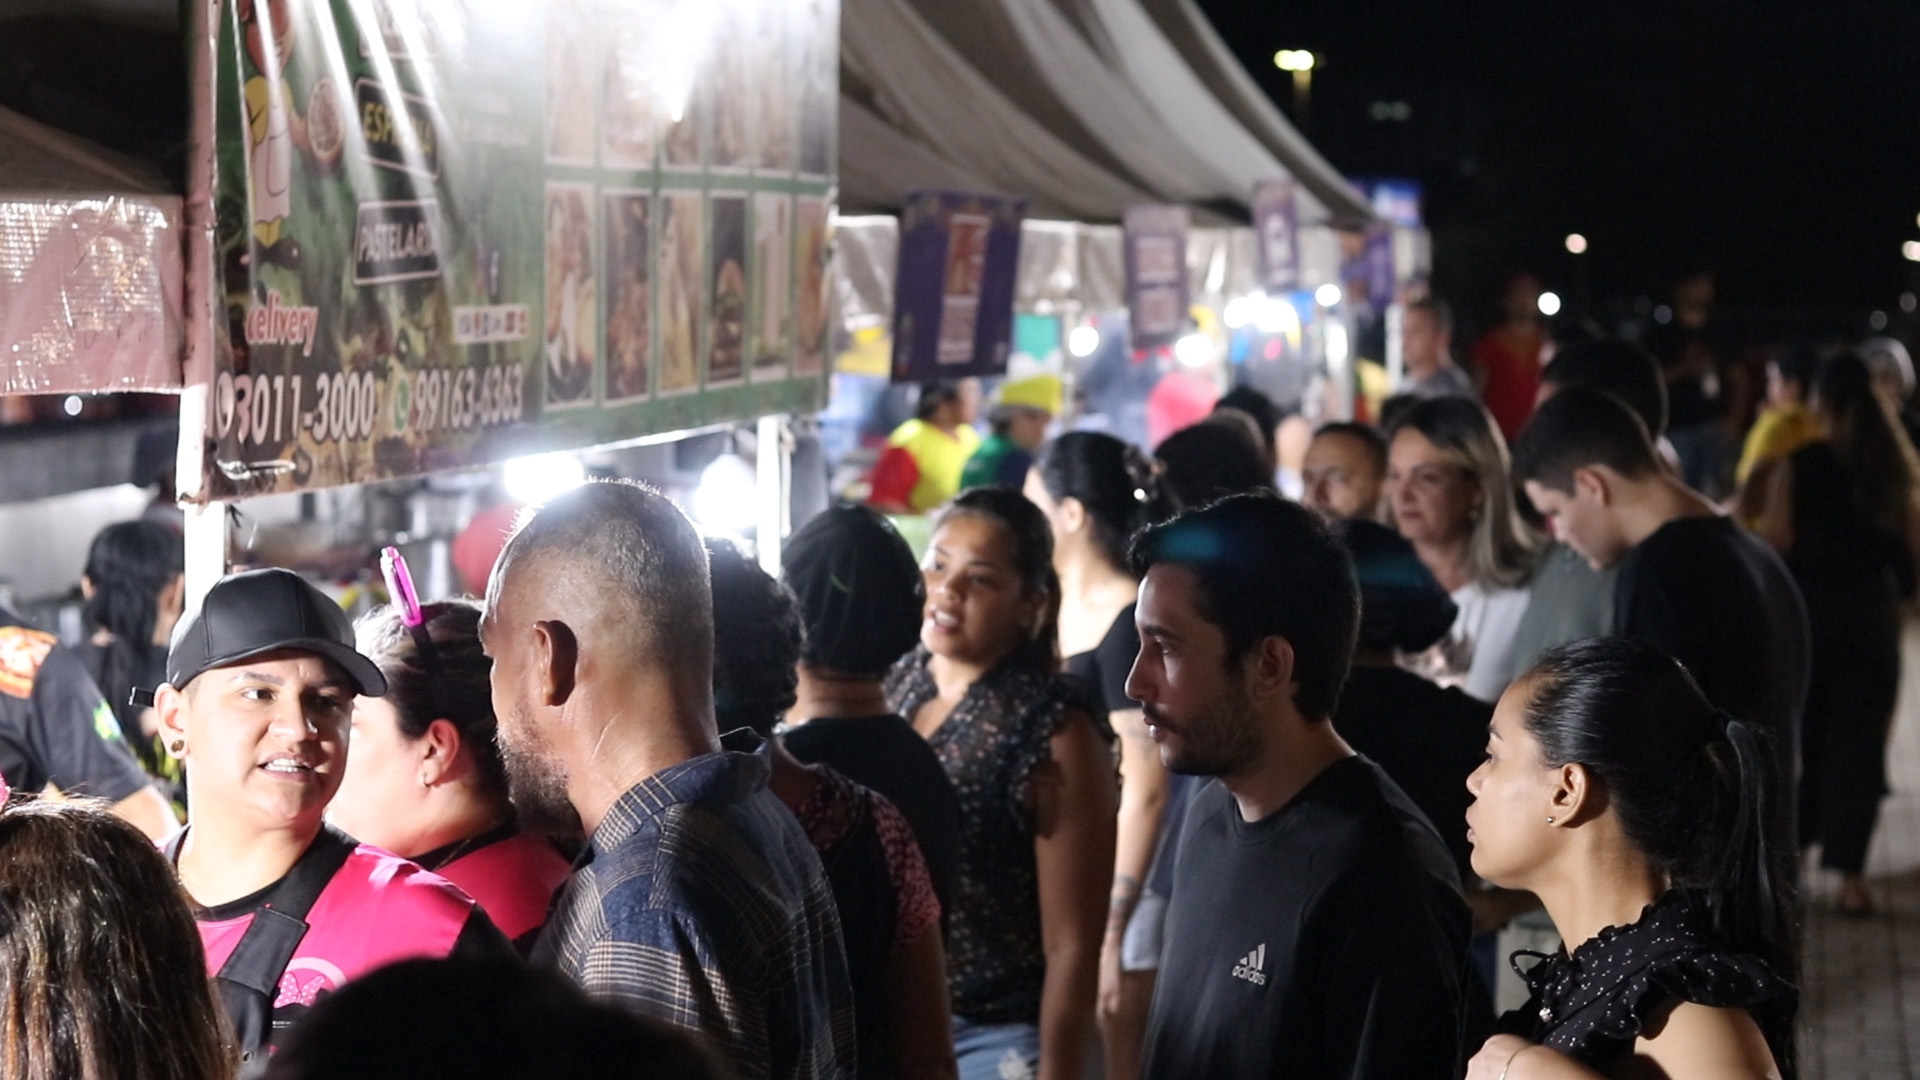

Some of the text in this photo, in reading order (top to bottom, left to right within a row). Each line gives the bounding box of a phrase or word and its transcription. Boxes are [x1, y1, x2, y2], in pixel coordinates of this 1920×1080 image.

[235, 364, 523, 445] 3011-3000 99163-6363
[1232, 965, 1265, 985] adidas
